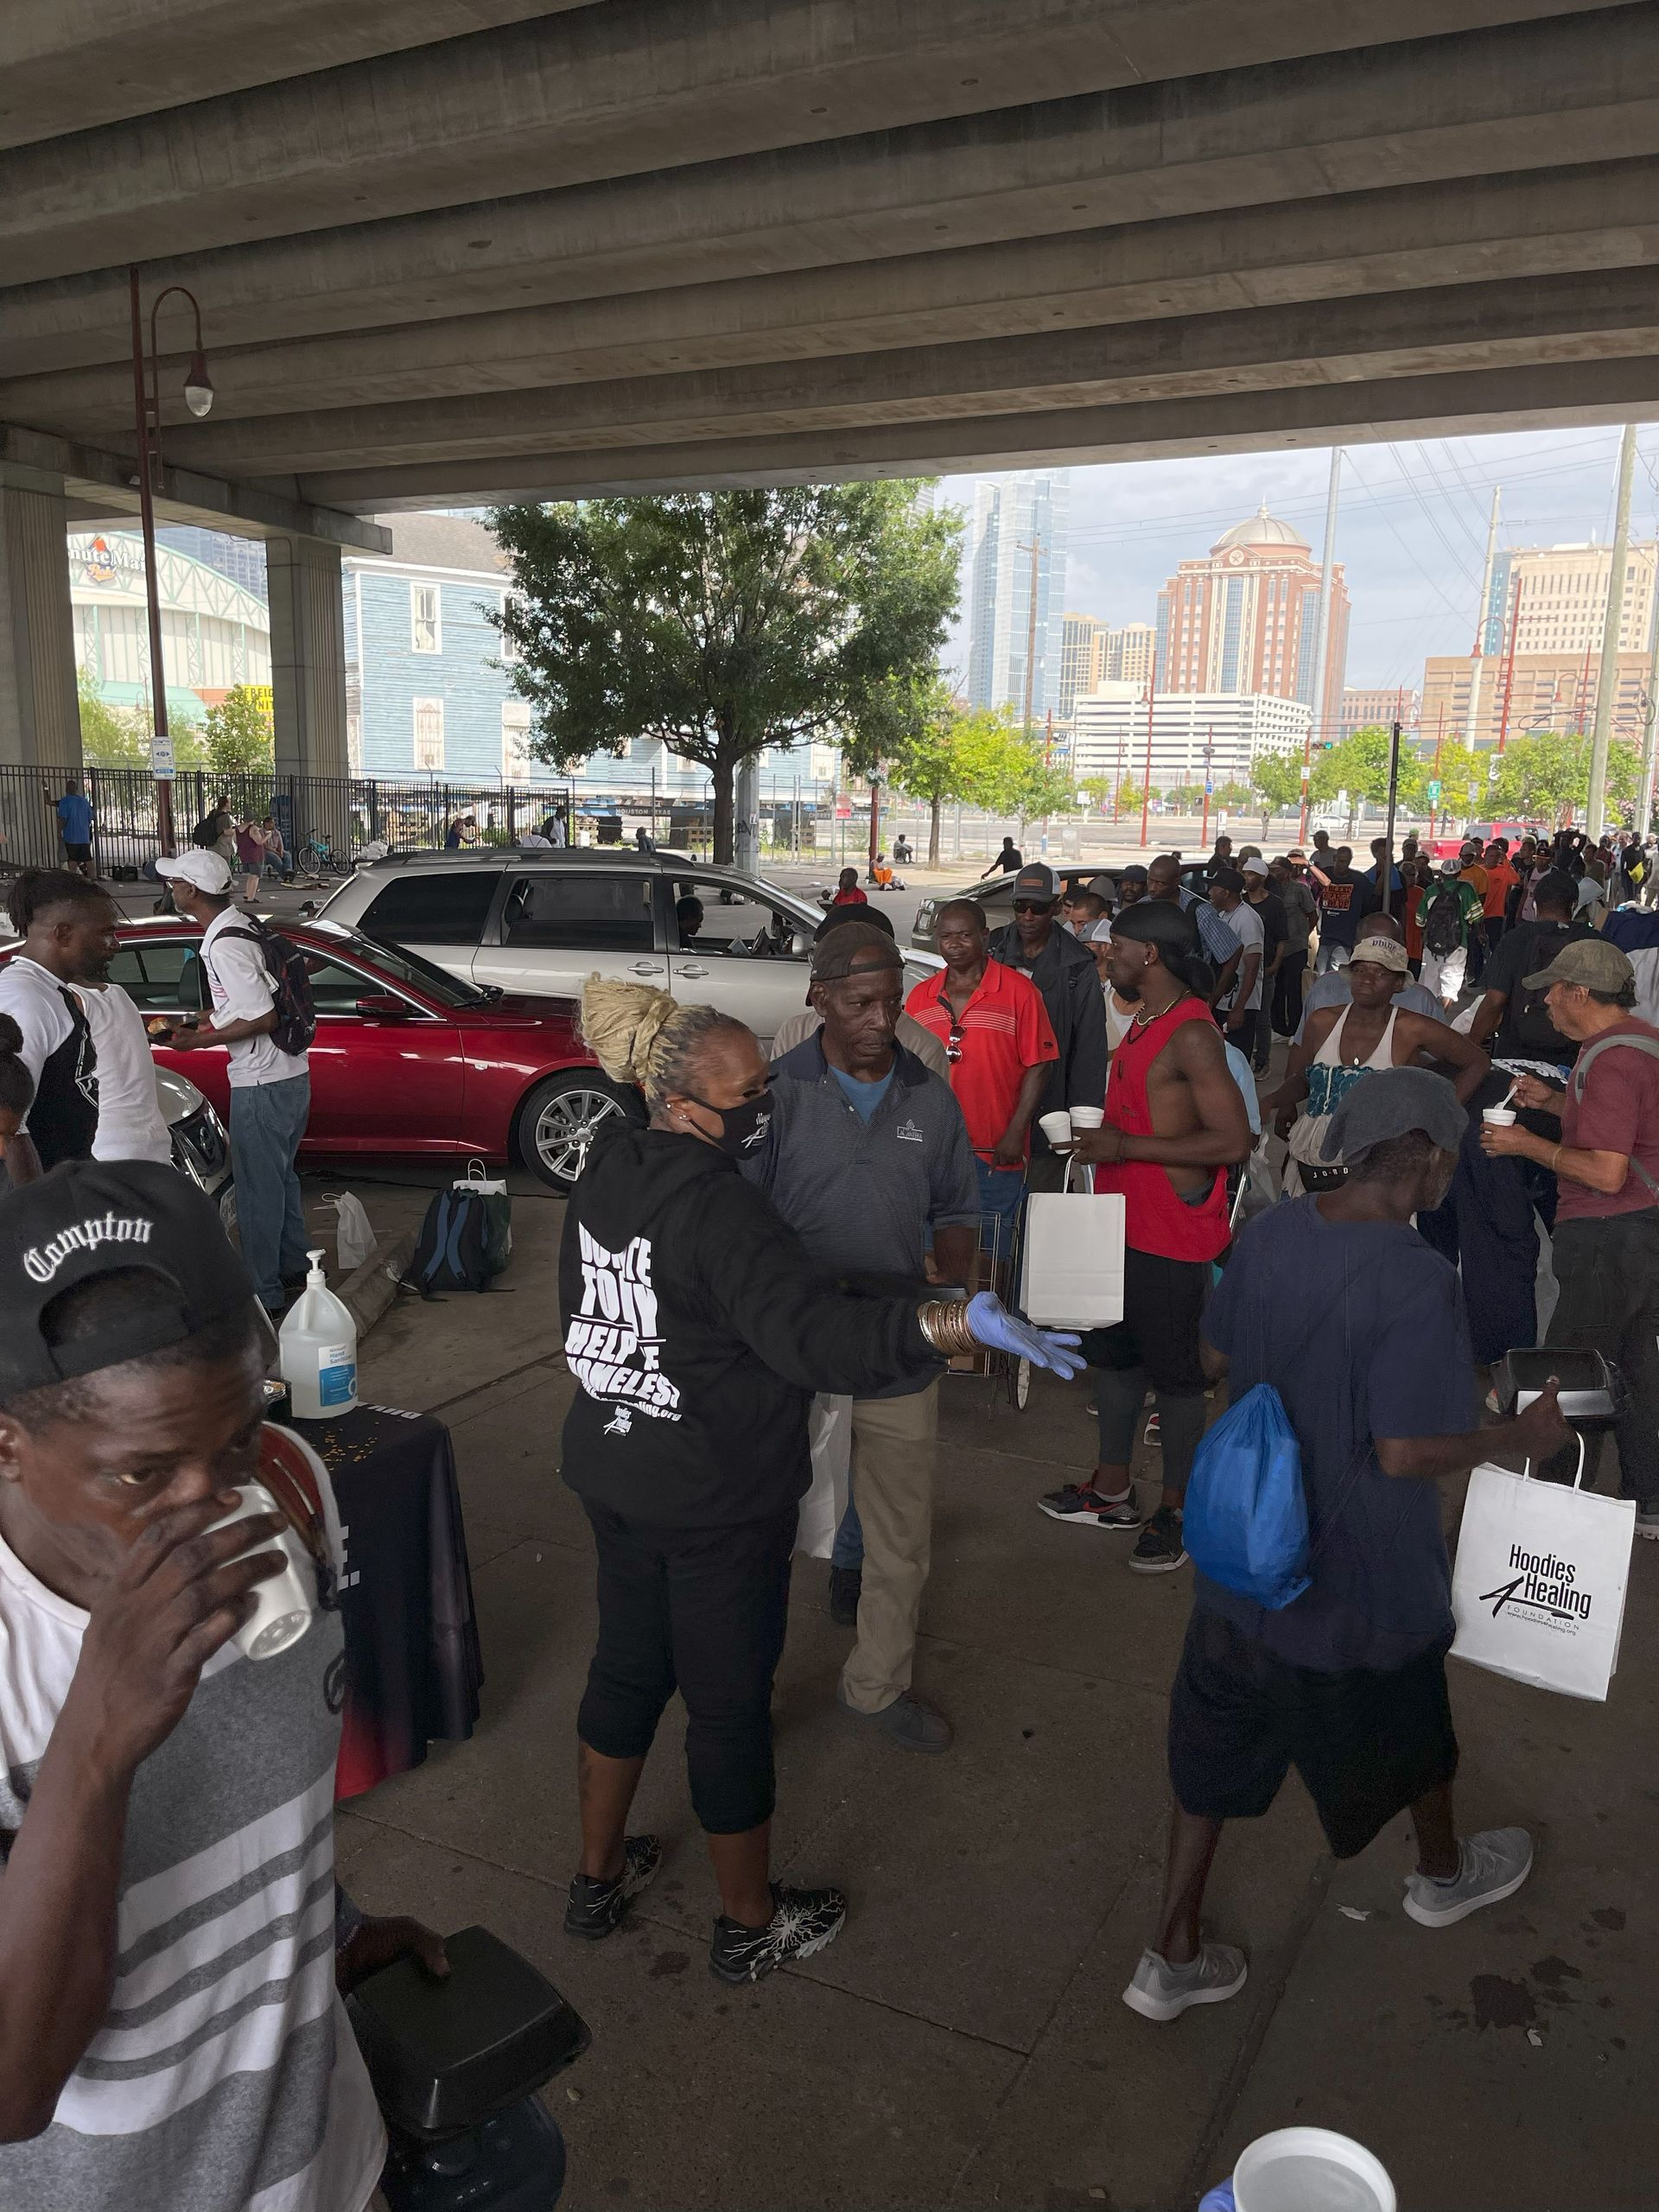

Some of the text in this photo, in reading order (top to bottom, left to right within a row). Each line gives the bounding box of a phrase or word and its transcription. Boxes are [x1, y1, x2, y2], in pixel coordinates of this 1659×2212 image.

[69, 547, 146, 573] nute Mai
[245, 688, 273, 697] FREIG
[1313, 1166, 1349, 1179] JORD
[23, 1211, 154, 1282] Compton
[564, 1320, 638, 1365] HELP
[1509, 1543, 1576, 1584] Hoodies
[1523, 1573, 1592, 1620] Healing
[1507, 1605, 1580, 1631] FOUNDATION
